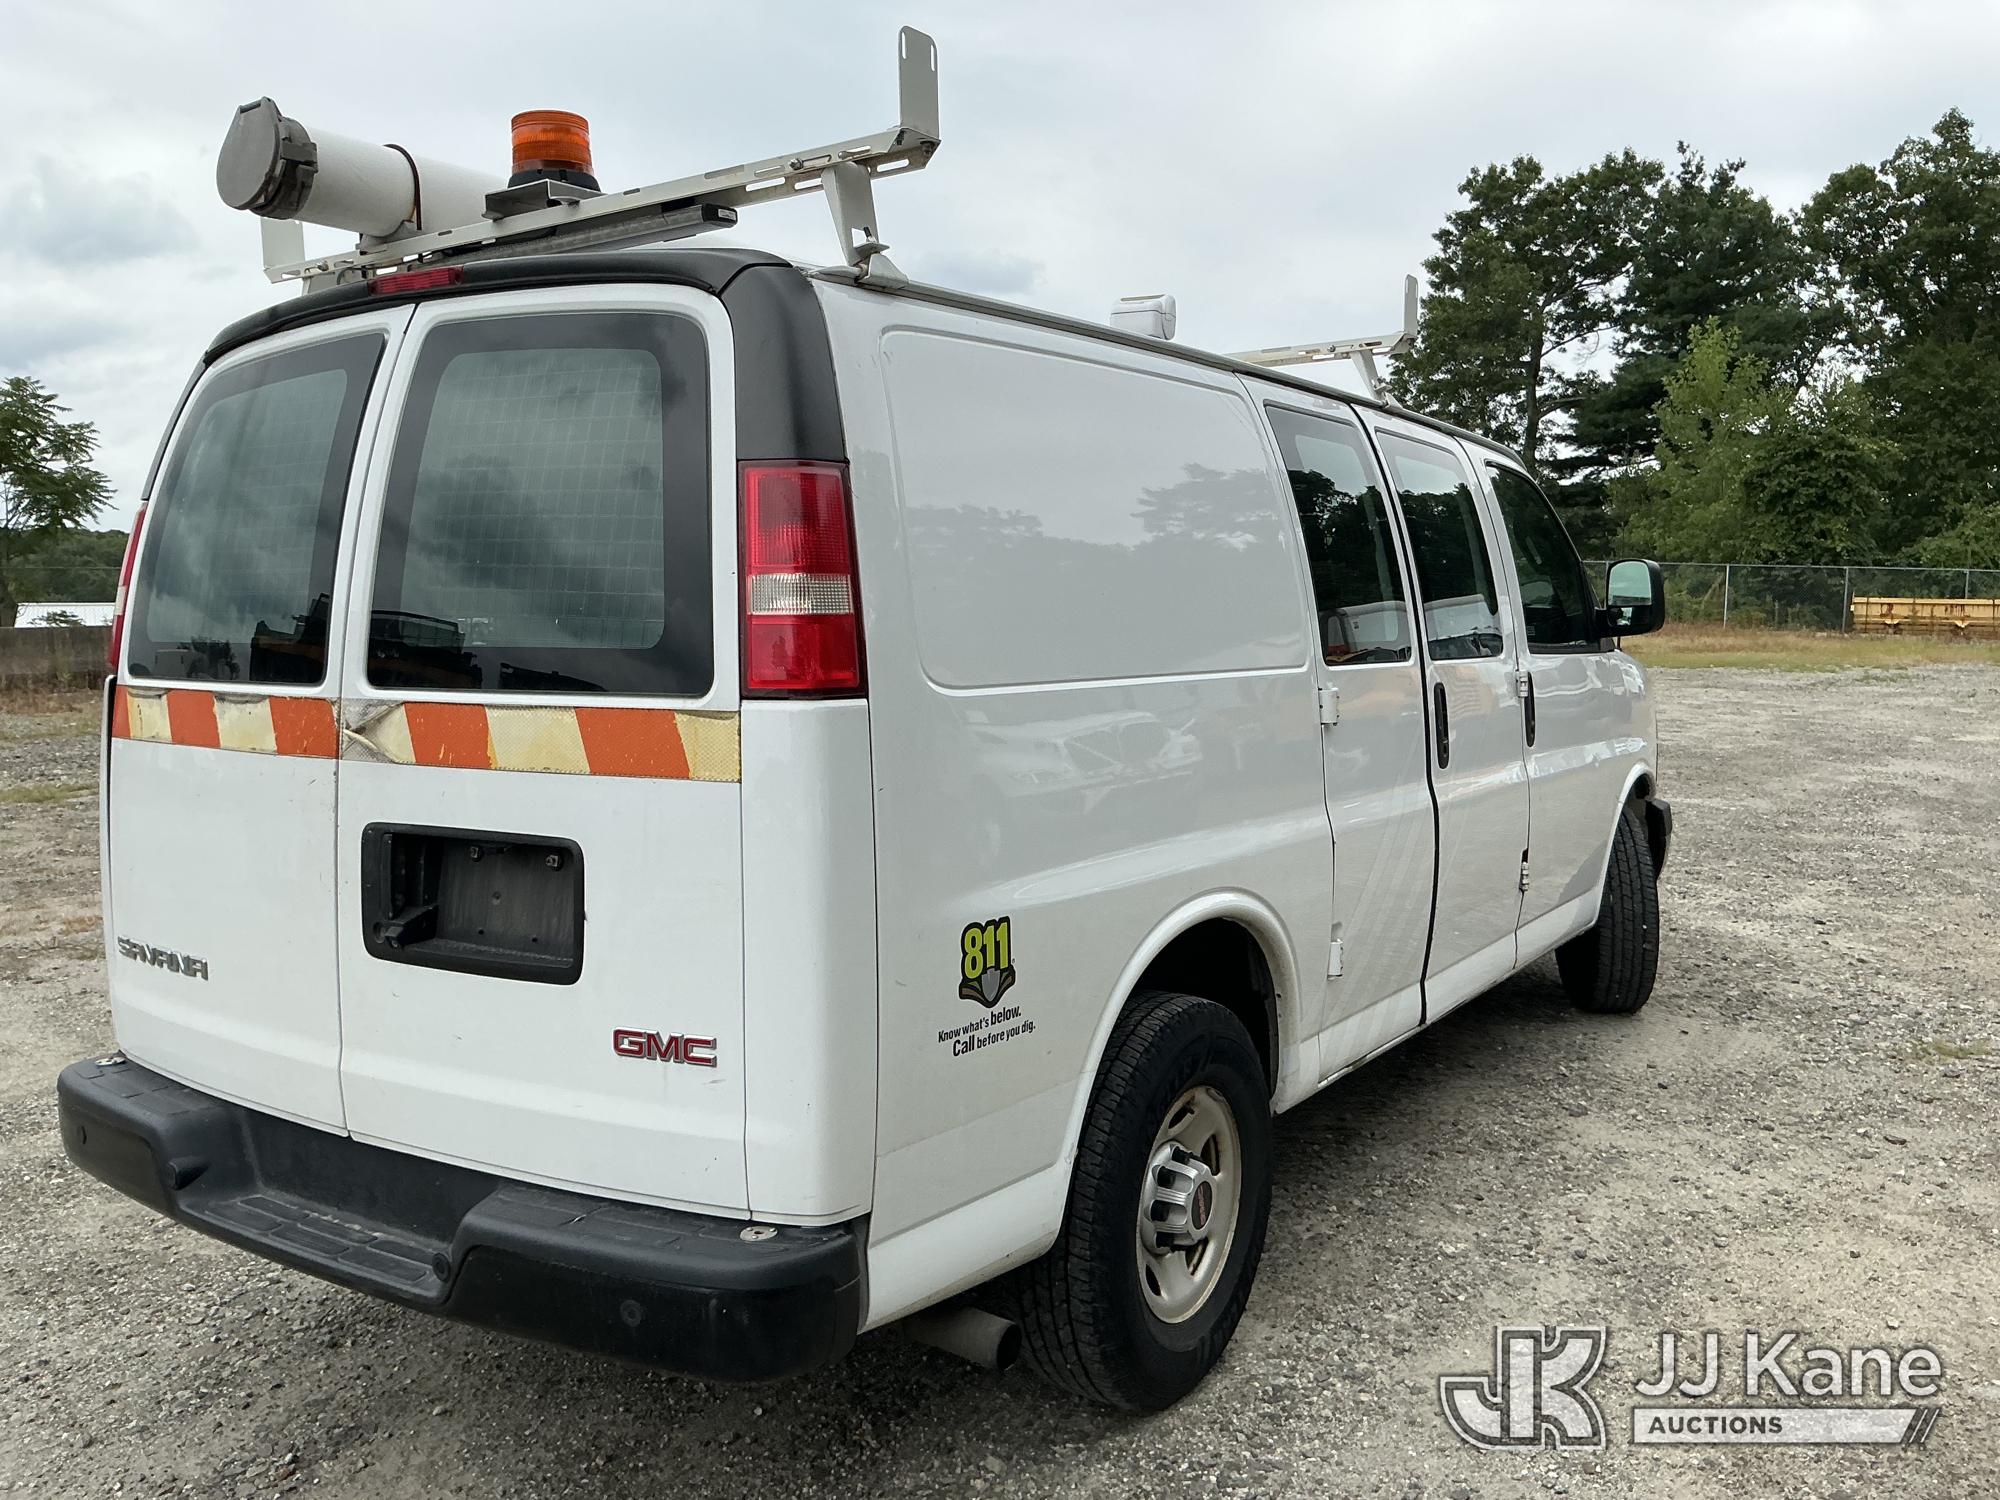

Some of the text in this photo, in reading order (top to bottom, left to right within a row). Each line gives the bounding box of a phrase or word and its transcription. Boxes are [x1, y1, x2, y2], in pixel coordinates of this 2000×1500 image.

[117, 935, 209, 981] SAVANA
[963, 920, 1009, 980] 811
[938, 1005, 1022, 1043] Know what's below.
[952, 1019, 1036, 1057] Call before you dig.
[613, 1027, 718, 1068] GMC
